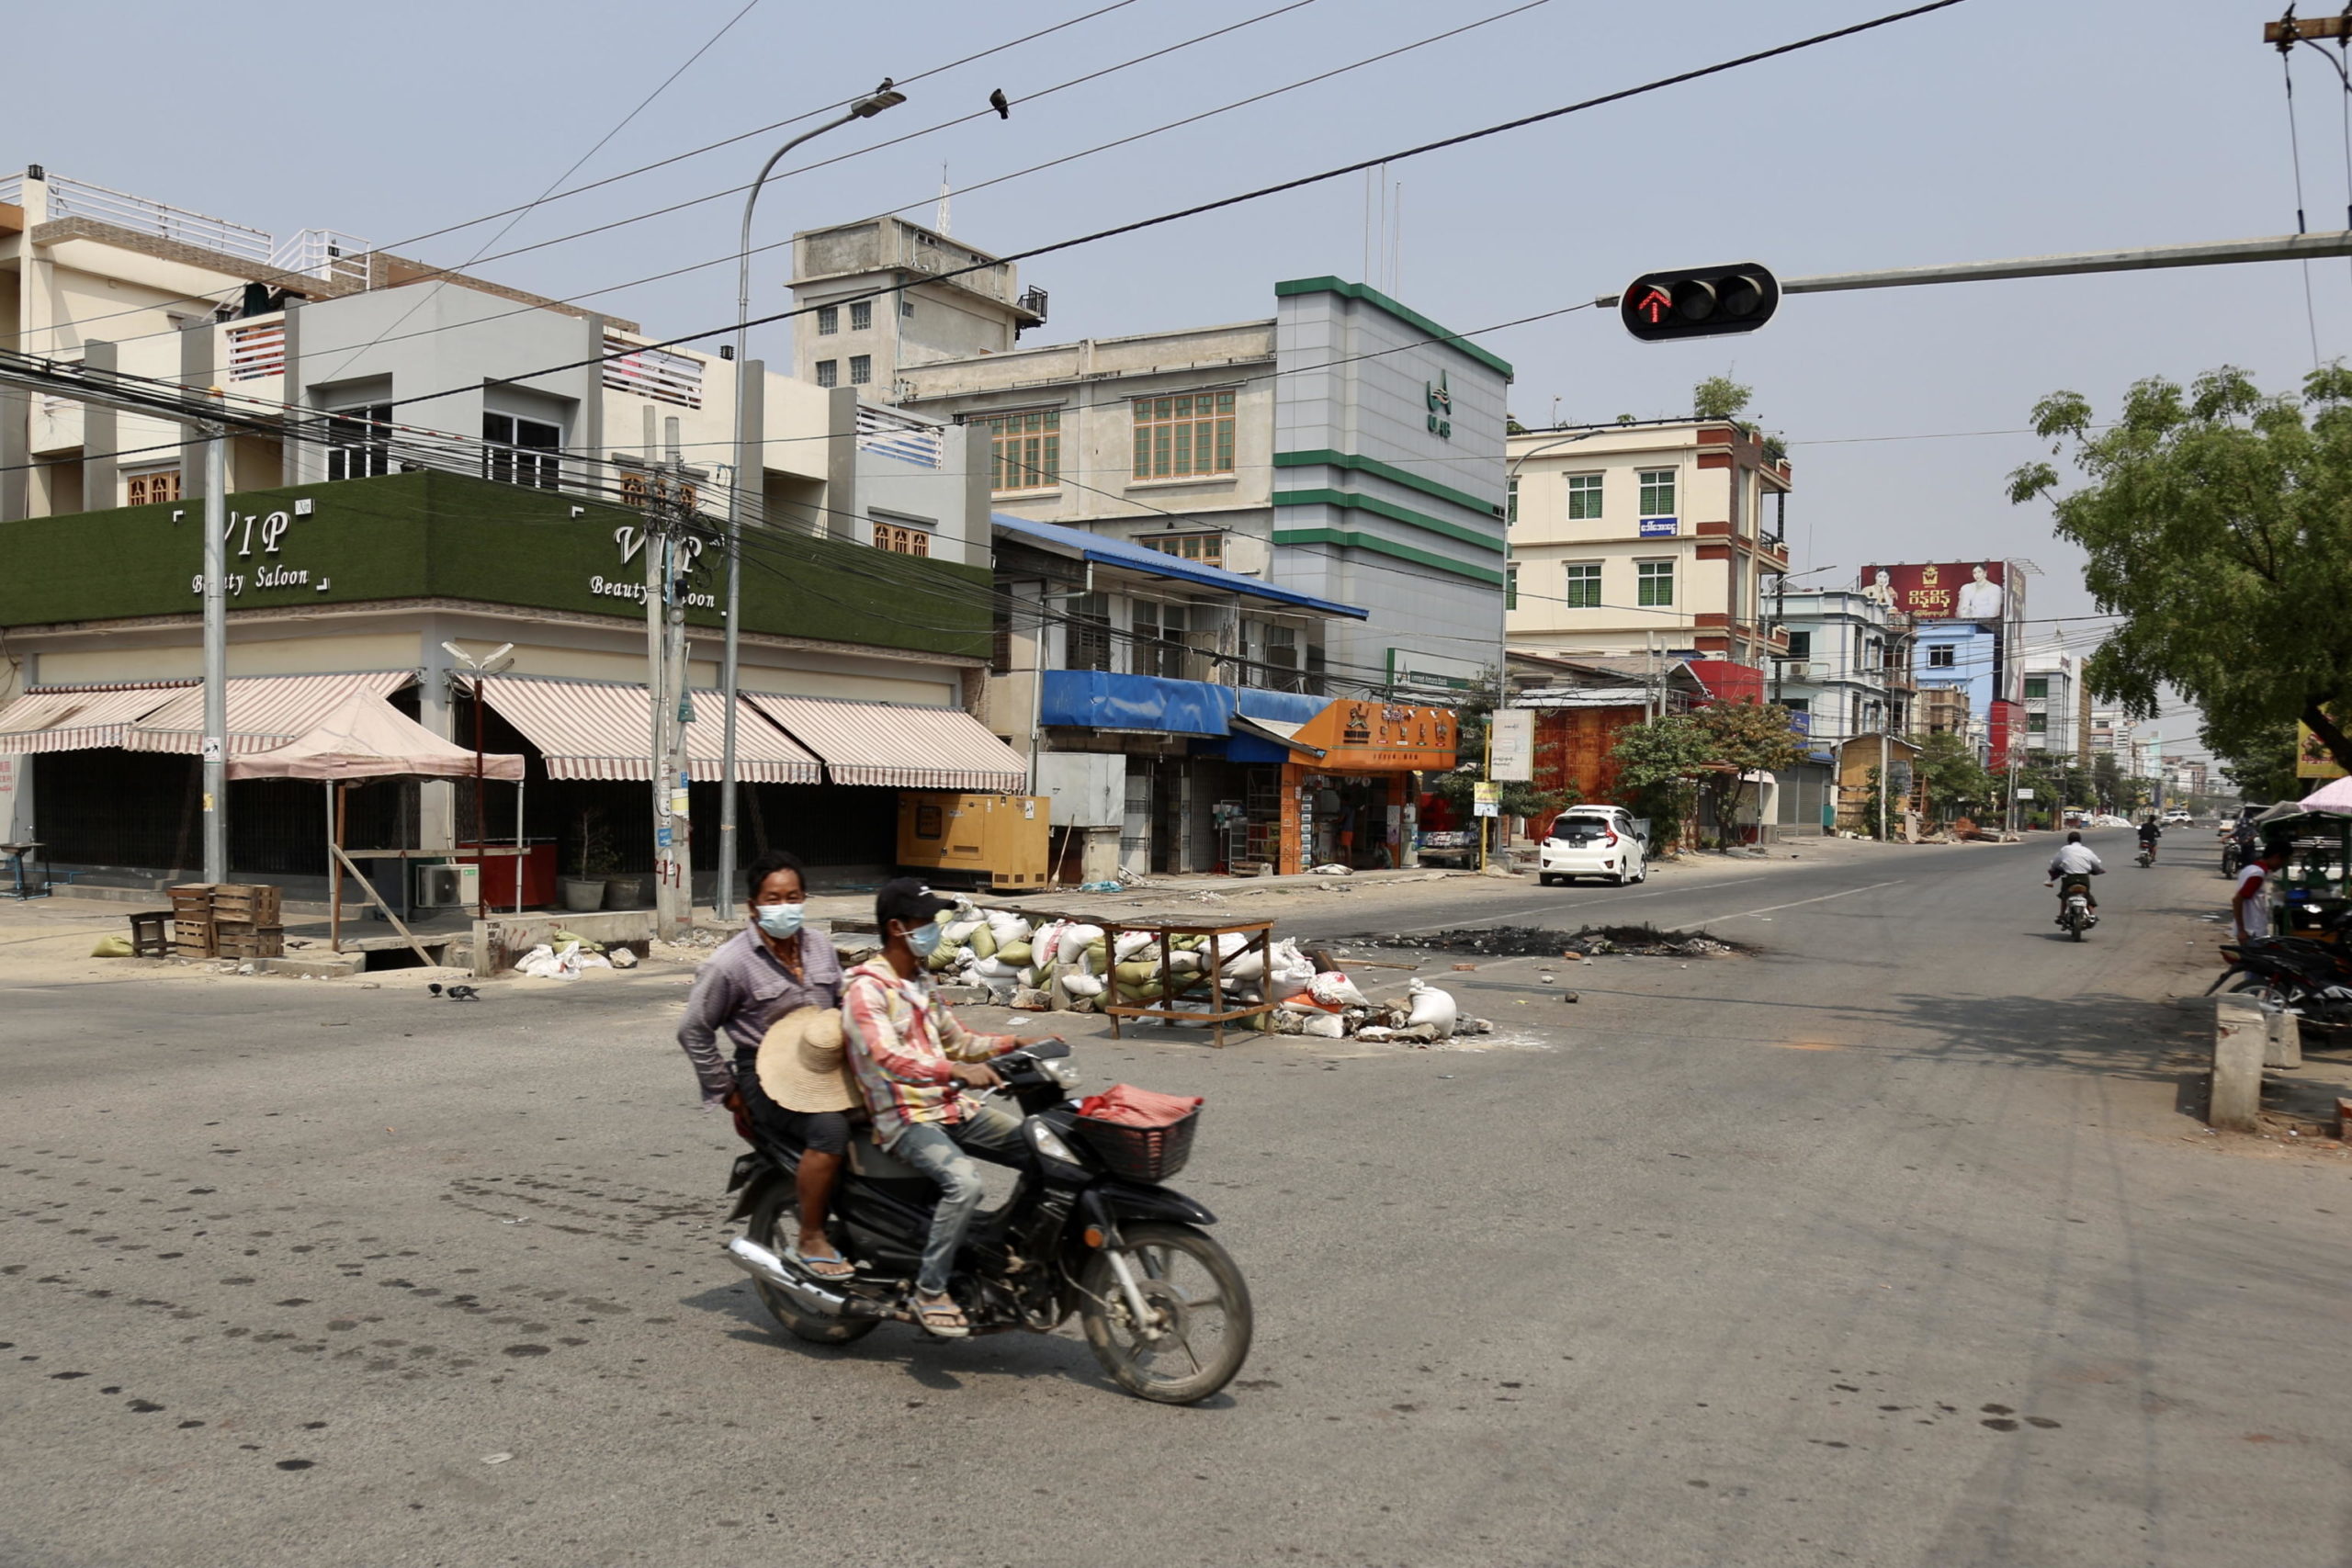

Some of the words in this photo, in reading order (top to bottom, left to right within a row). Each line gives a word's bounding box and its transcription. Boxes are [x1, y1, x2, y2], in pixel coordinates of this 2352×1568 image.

[192, 573, 244, 596] Bty
[255, 563, 310, 588] Saloon
[590, 575, 649, 606] Beauty
